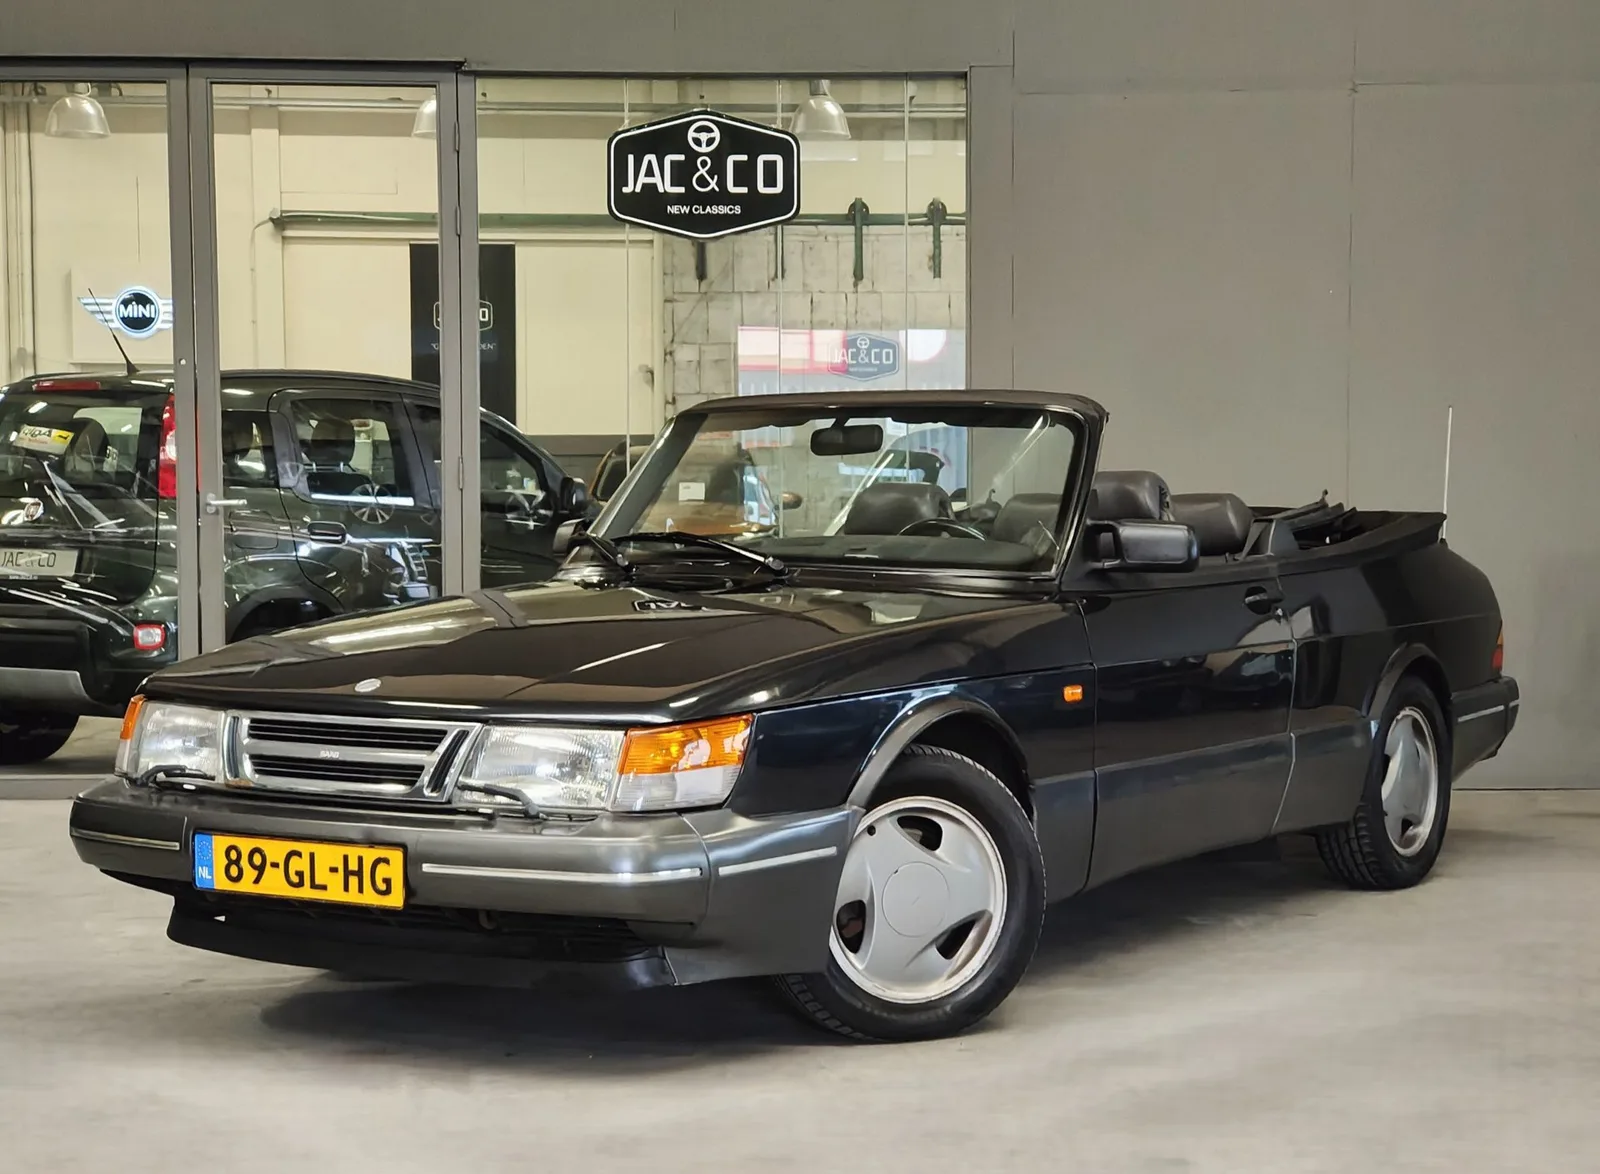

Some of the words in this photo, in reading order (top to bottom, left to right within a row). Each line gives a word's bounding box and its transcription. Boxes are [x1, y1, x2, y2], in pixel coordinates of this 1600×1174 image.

[667, 205, 690, 214] NEW
[692, 205, 741, 215] CLASSICS
[119, 303, 155, 318] MINI
[199, 866, 212, 879] NL
[224, 844, 393, 896] 89-GL-HG
